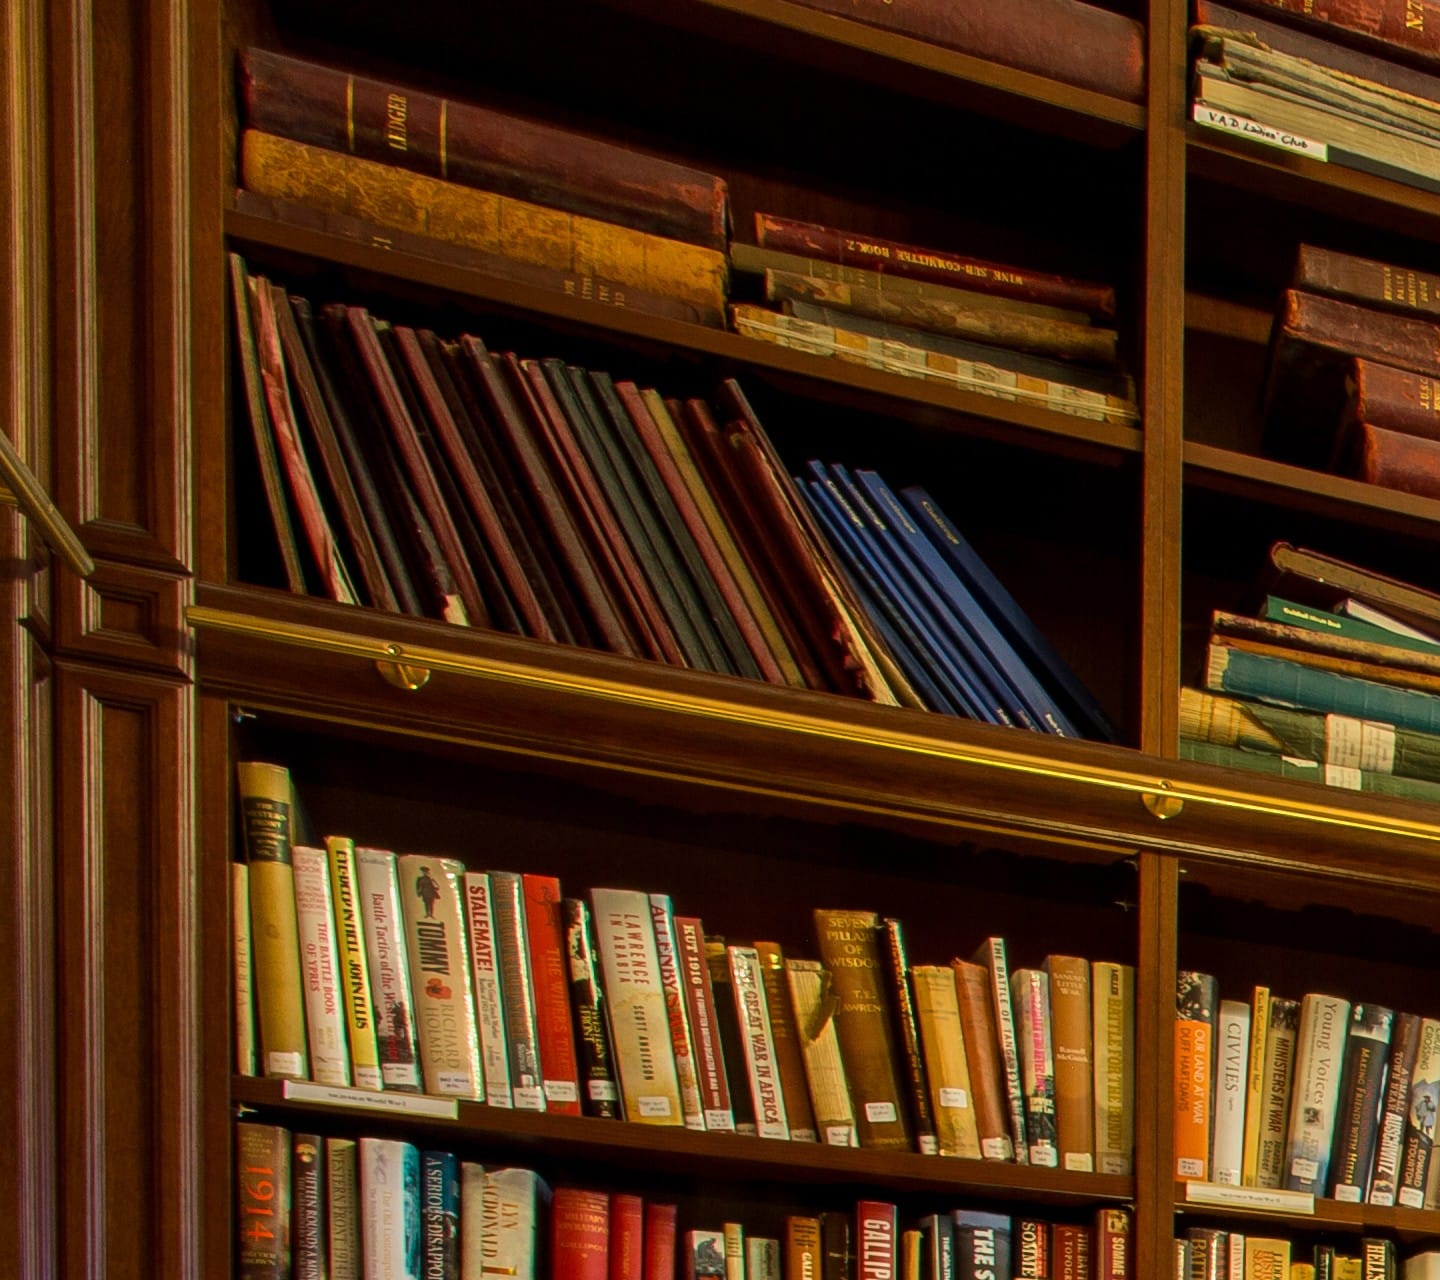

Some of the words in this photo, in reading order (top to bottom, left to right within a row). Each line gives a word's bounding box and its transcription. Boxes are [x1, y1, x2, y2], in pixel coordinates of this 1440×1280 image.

[387, 93, 407, 151] LEDGER
[1281, 135, 1308, 149] Club
[416, 920, 450, 976] TOMMY
[469, 885, 494, 972] STALEMATE!
[625, 913, 650, 987] LAWRENCE
[319, 944, 333, 985] BATTLE
[613, 935, 626, 983] ARABIA
[324, 987, 335, 1015] BOOK
[1316, 1002, 1338, 1049] Young
[424, 1007, 446, 1064] HOLMES
[440, 1003, 459, 1070] RICHARD
[1225, 1022, 1242, 1093] CIVVIES
[1420, 1025, 1434, 1070] CROSSING
[760, 1080, 780, 1125] AFRICA
[1314, 1054, 1332, 1106] Voices
[1378, 1113, 1402, 1178] AUSCHWITZ
[246, 1166, 275, 1242] 1914
[502, 1202, 519, 1231] LYN
[972, 1229, 994, 1267] THE
[1022, 1221, 1037, 1277] SOMME
[1111, 1237, 1125, 1276] SOMME
